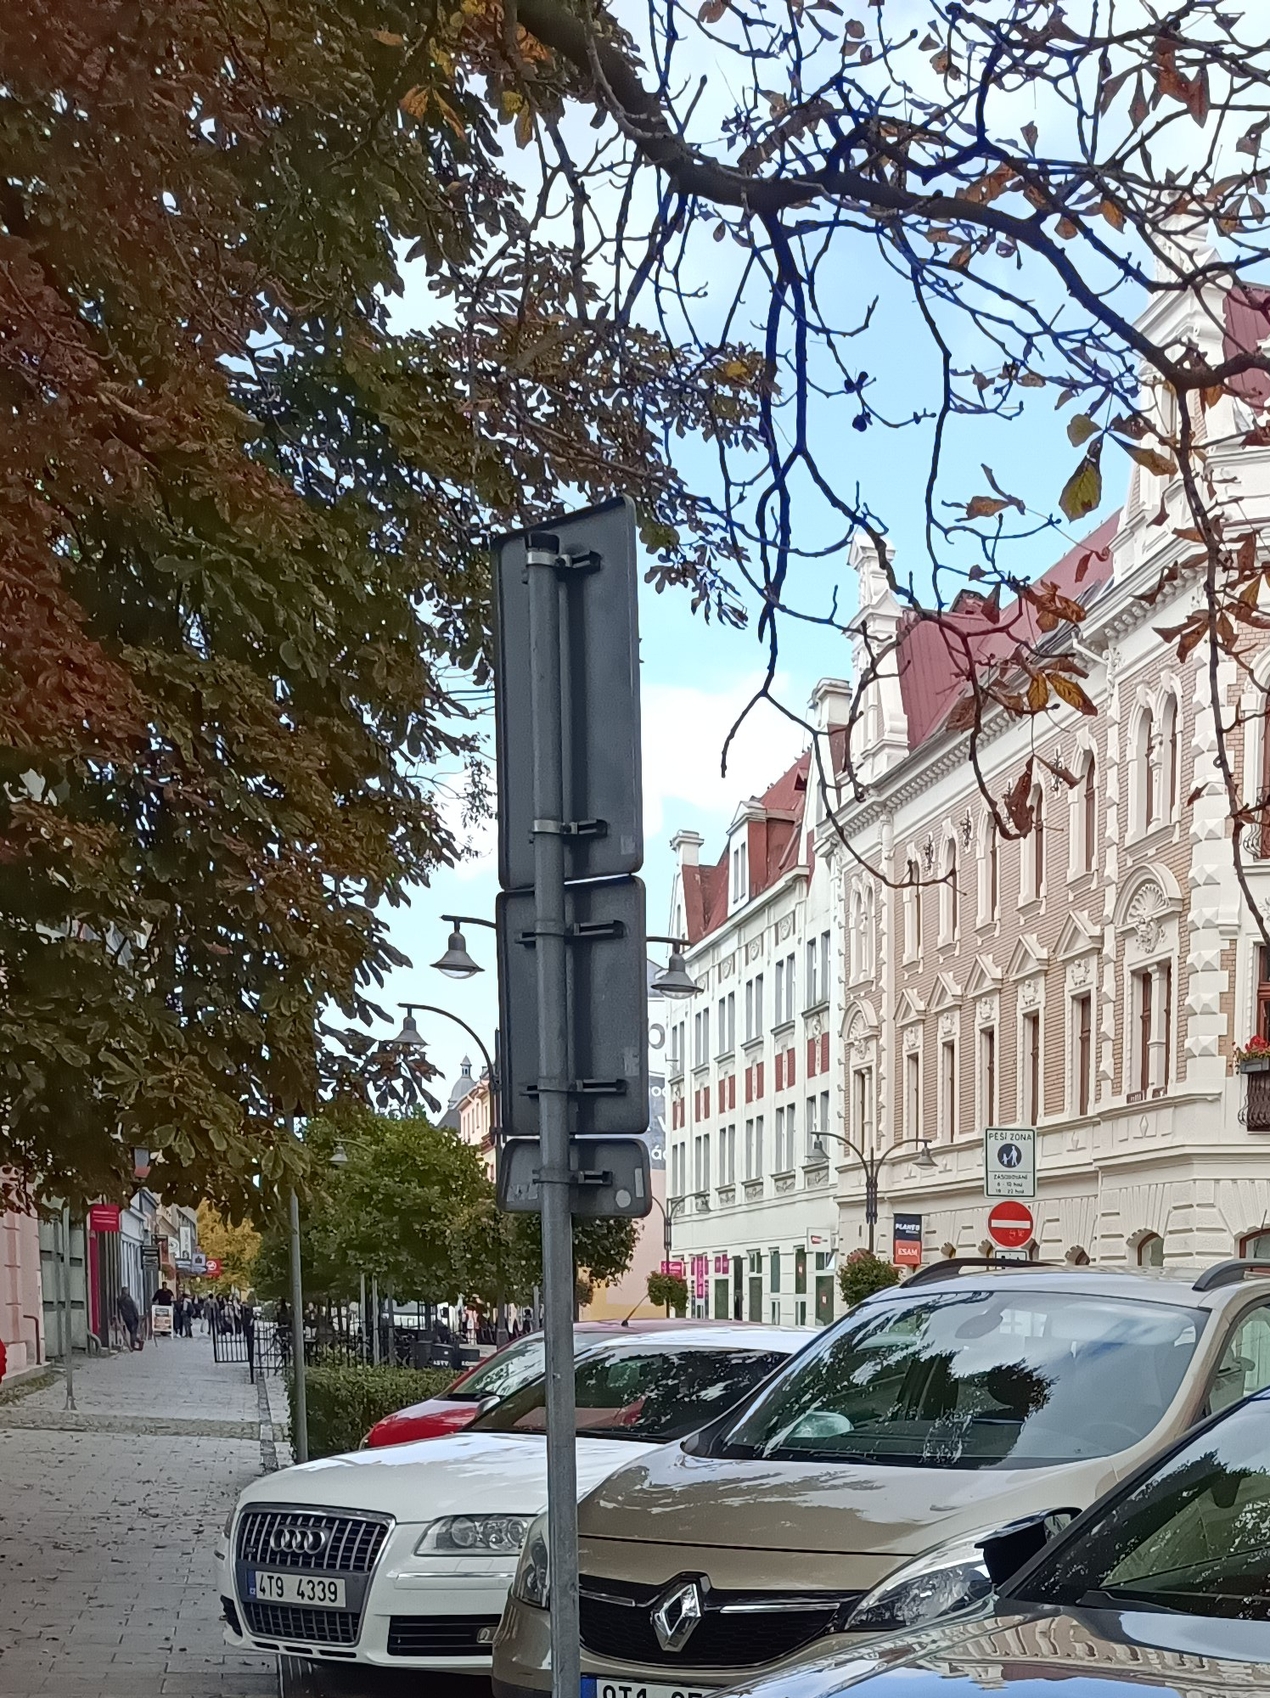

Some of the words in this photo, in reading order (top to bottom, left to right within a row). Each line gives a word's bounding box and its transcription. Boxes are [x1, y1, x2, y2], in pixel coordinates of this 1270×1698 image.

[898, 1248, 918, 1257] ESAM
[259, 1574, 284, 1598] 4T9
[296, 1578, 338, 1603] 4339
